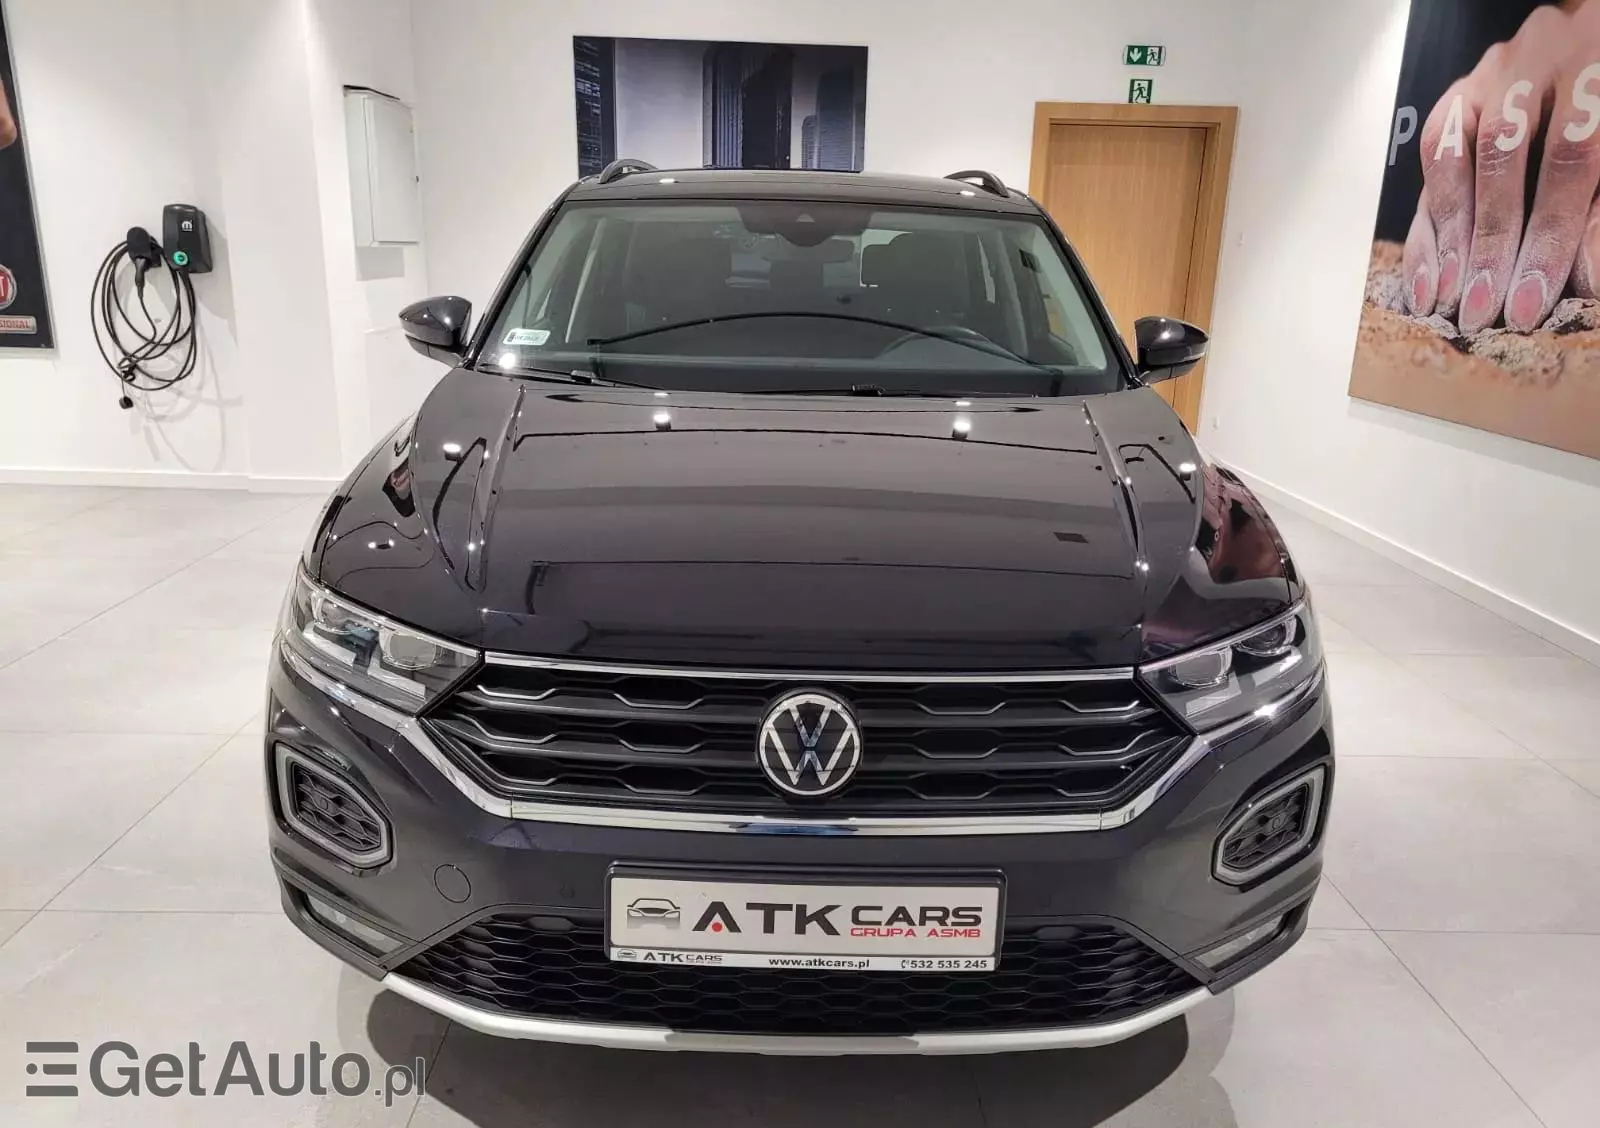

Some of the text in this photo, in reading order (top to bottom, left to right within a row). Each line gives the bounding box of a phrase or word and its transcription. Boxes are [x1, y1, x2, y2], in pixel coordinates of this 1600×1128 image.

[692, 901, 983, 936] ATK CARS
[850, 928, 981, 938] GRUPA ASMB
[643, 952, 684, 963] ATK
[686, 954, 723, 962] CARS
[769, 958, 870, 969] www.atkcars.pl
[911, 960, 988, 969] 532 535 245
